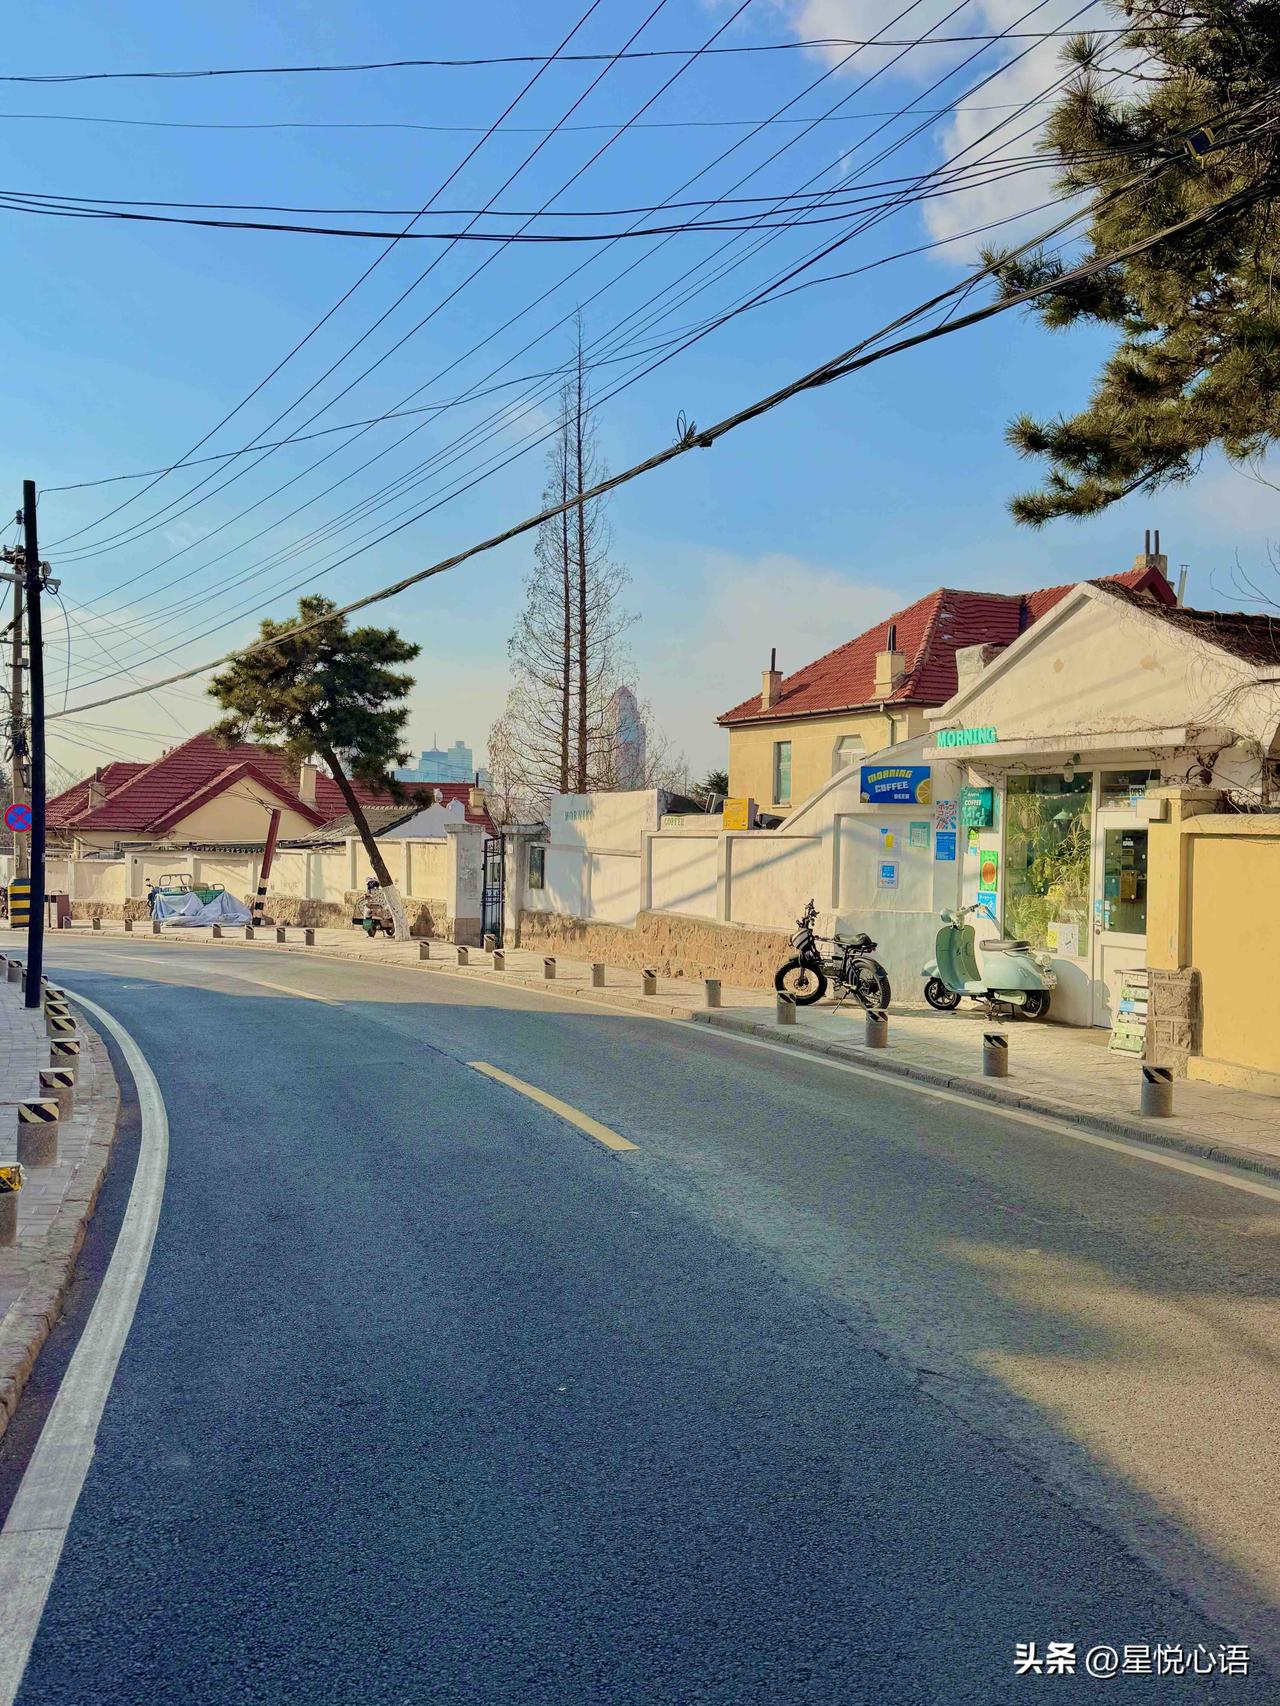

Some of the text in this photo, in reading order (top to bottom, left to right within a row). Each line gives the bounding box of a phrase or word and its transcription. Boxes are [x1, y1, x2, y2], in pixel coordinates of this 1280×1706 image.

[937, 727, 996, 748] MORNING
[875, 781, 909, 793] COFFEE
[1130, 787, 1145, 796] OPEN
